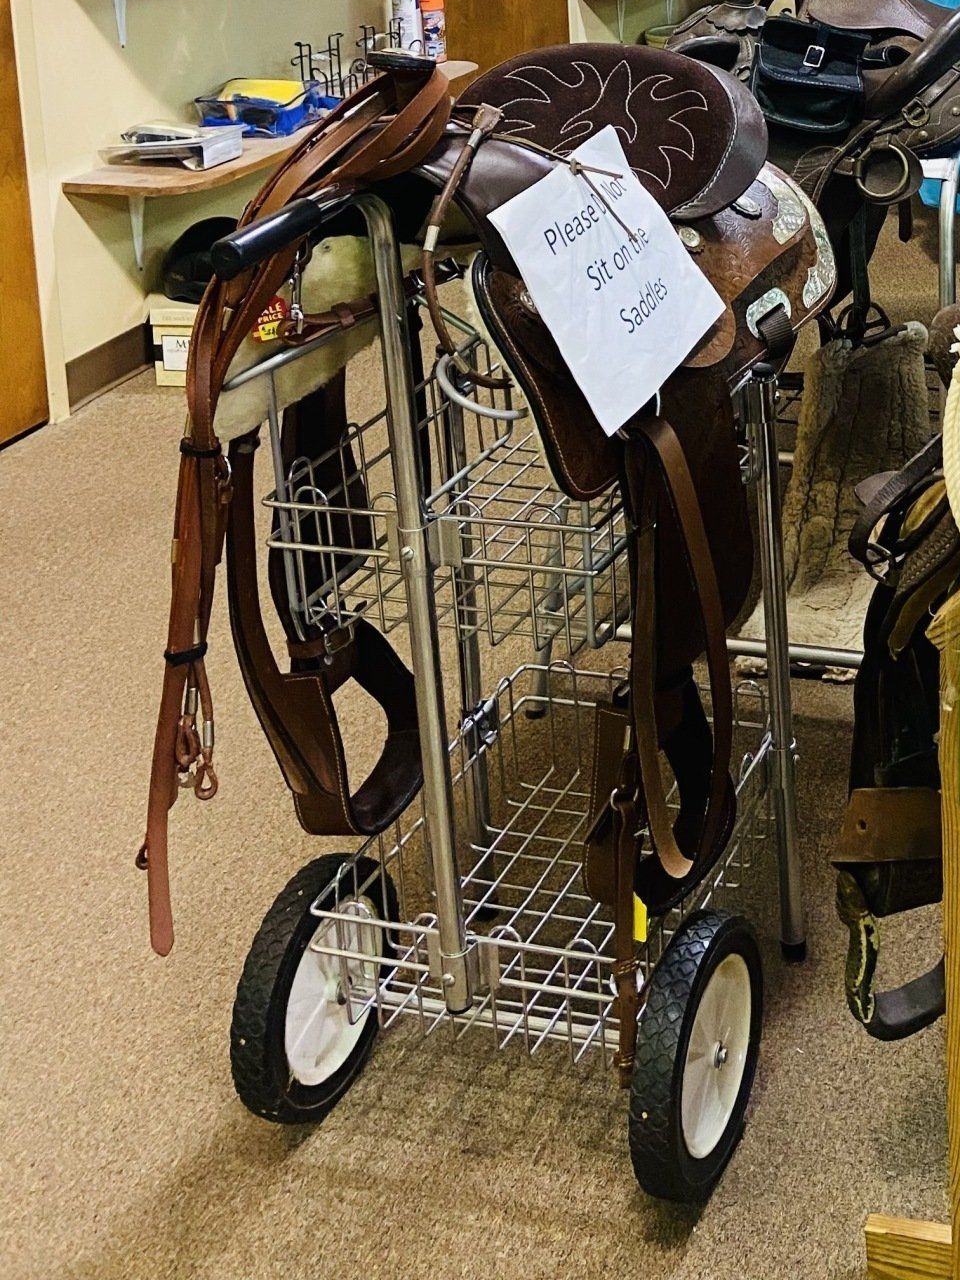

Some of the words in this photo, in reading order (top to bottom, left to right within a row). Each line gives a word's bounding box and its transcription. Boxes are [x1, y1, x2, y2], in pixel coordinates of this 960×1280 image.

[543, 204, 600, 256] Please
[607, 176, 628, 203] Not
[586, 256, 613, 291] Sit
[613, 243, 633, 271] on
[629, 225, 649, 254] the
[257, 312, 284, 324] PRICE
[261, 302, 283, 316] ALE
[619, 276, 668, 334] Saddles
